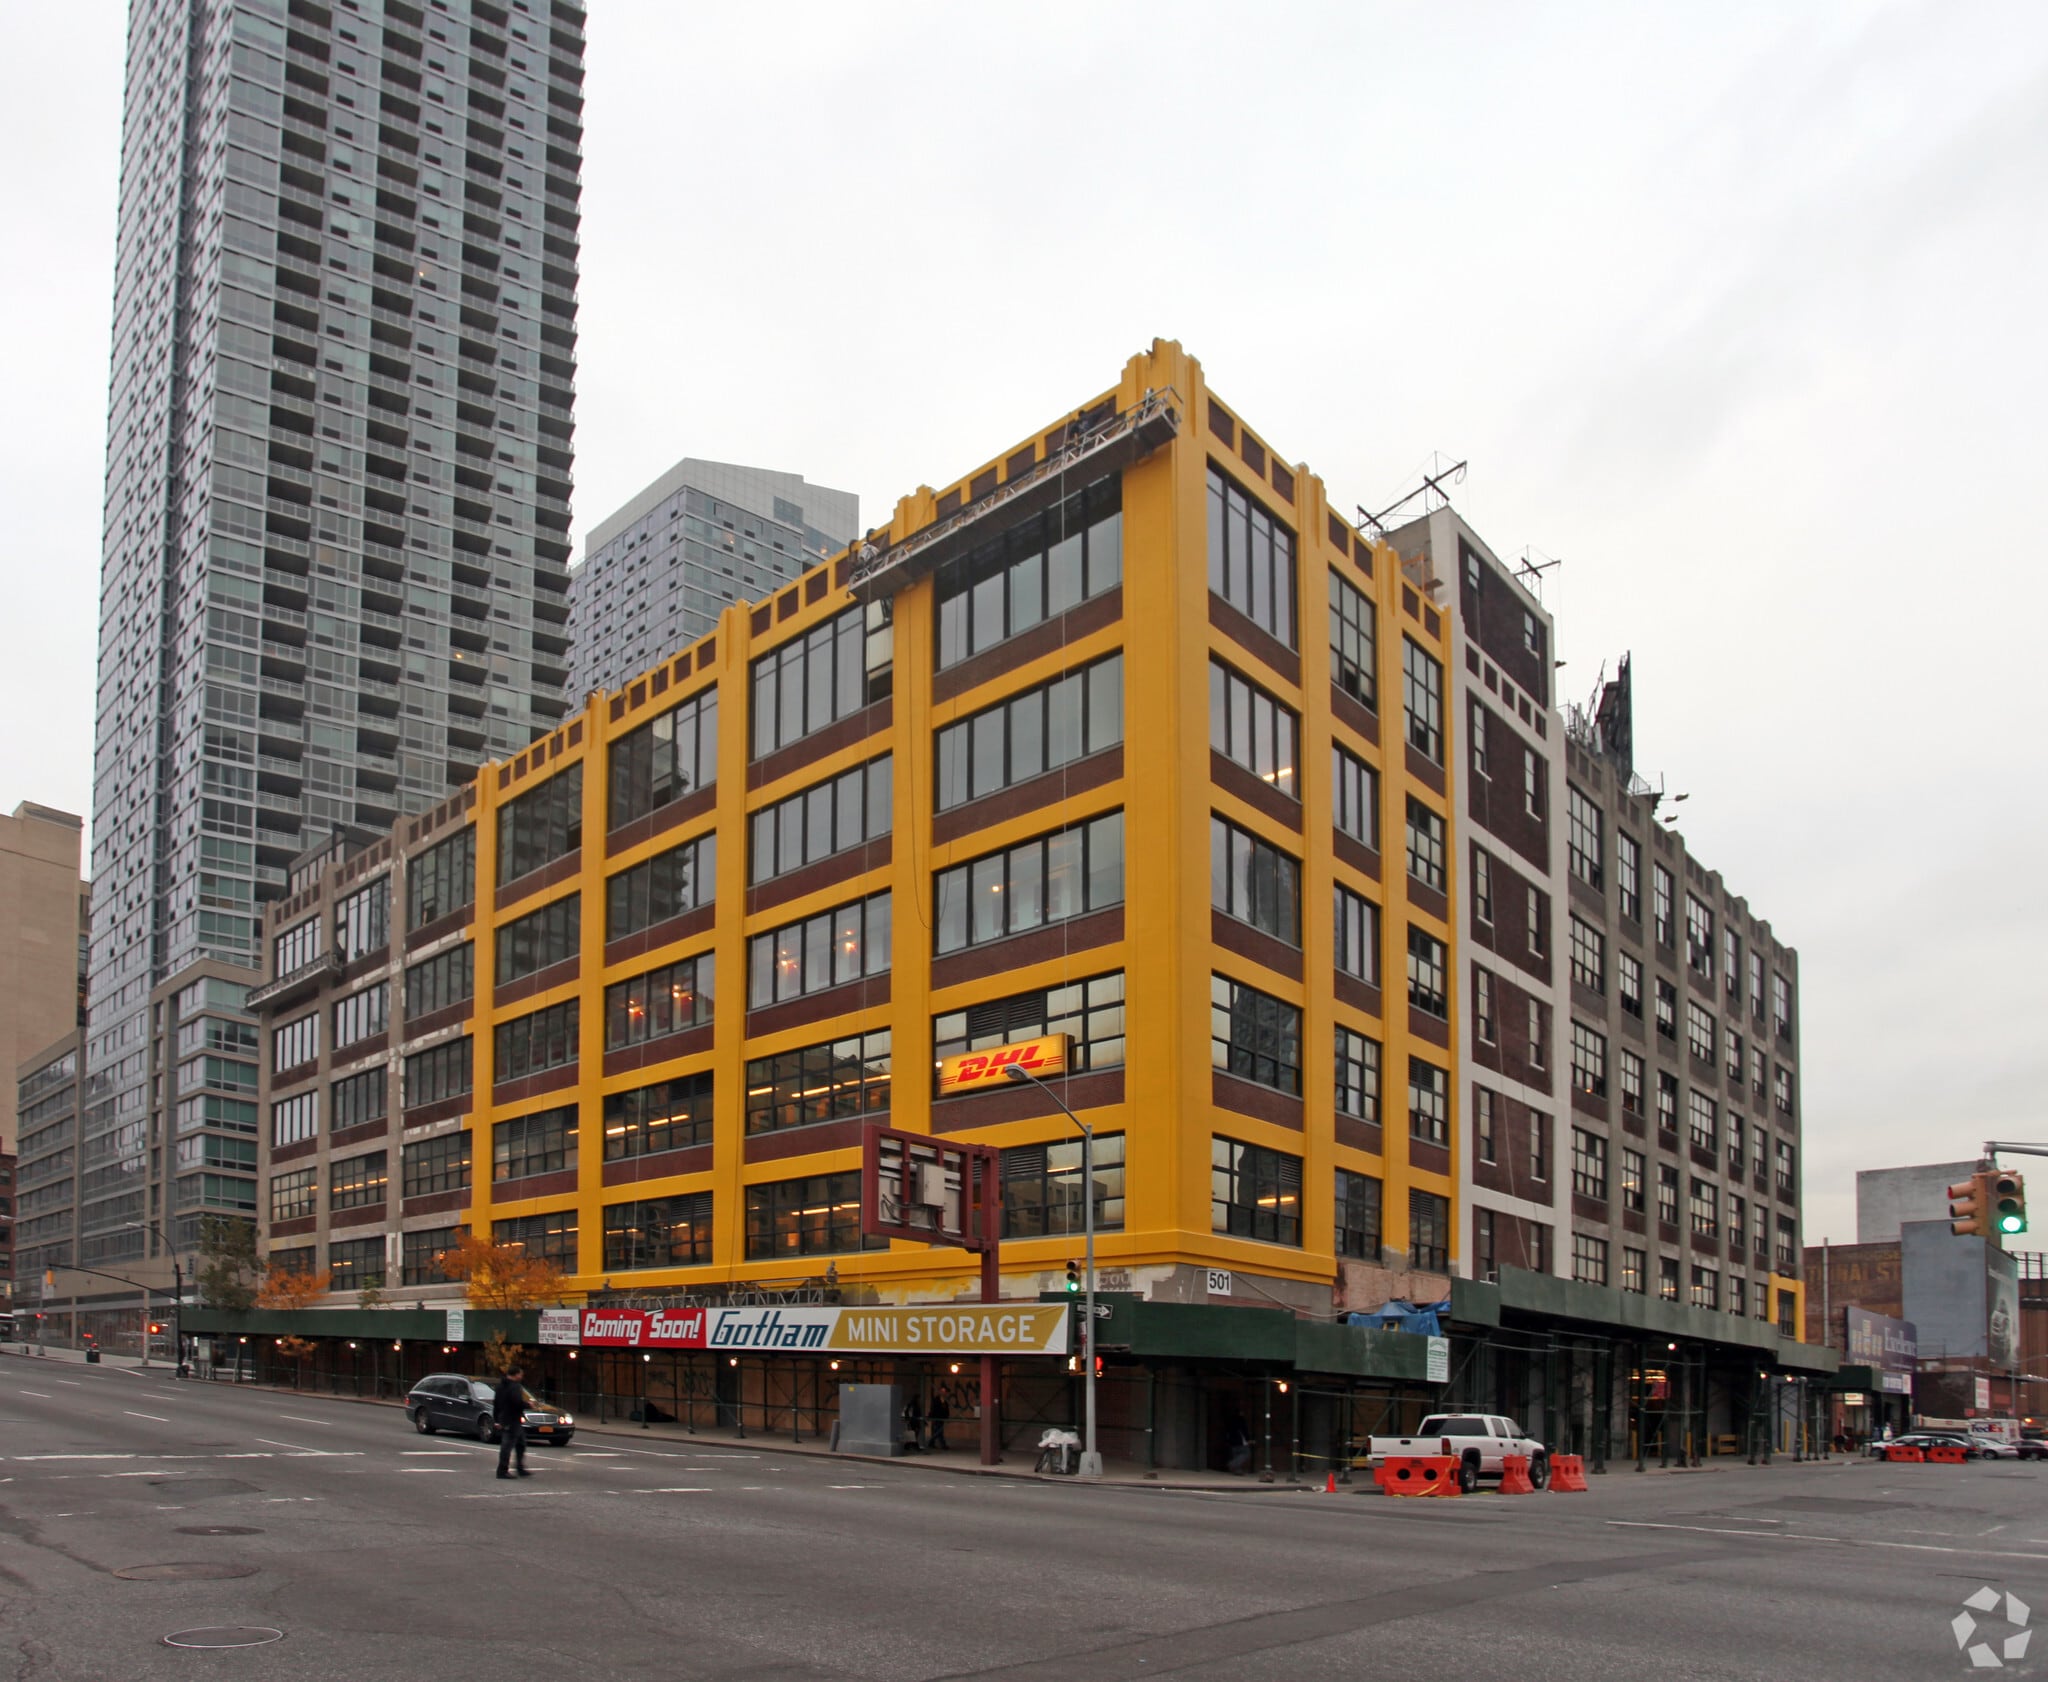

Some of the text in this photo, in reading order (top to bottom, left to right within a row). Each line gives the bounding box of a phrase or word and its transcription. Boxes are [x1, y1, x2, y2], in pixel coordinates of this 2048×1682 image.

[957, 1045, 1045, 1082] DHL
[1209, 1272, 1230, 1291] 501
[584, 1312, 702, 1345] Coming Soon!
[710, 1310, 1035, 1347] Gotham MINI STORAGE
